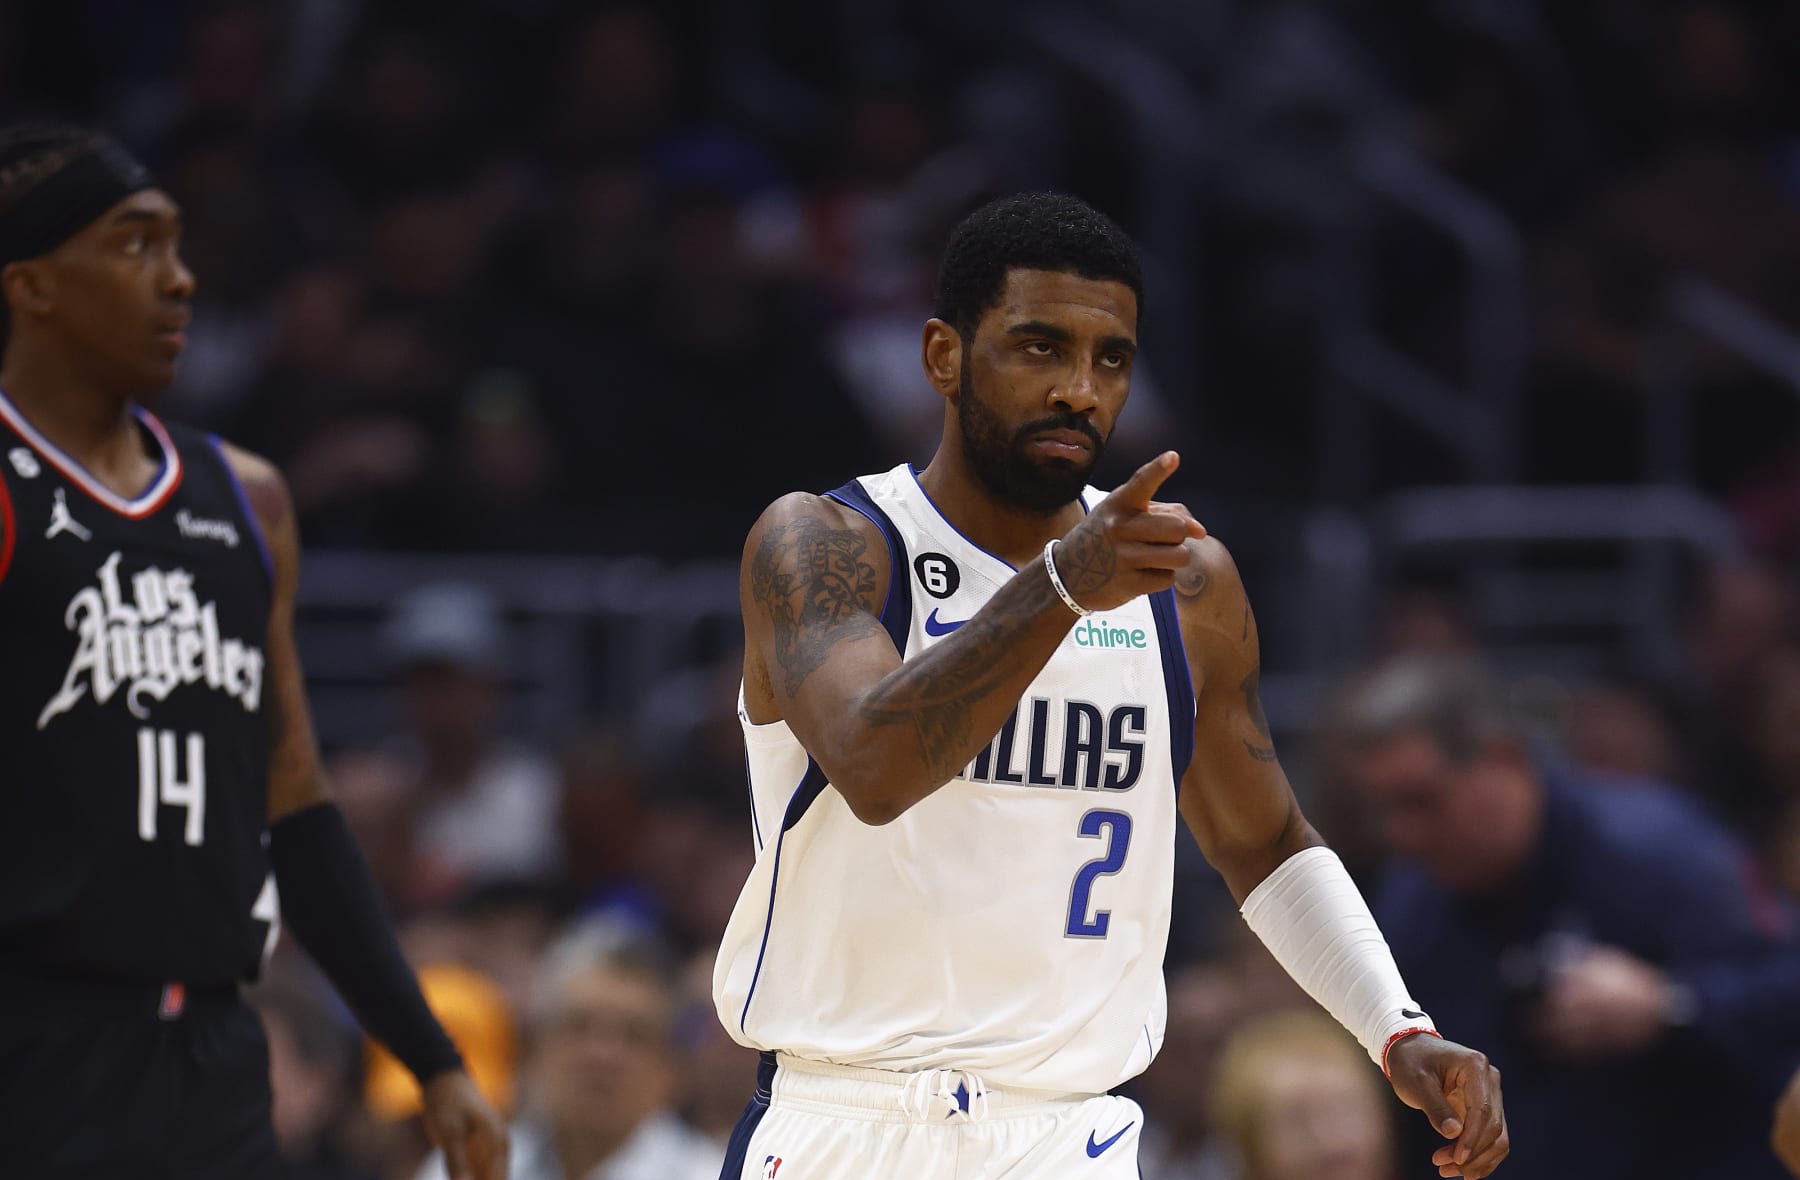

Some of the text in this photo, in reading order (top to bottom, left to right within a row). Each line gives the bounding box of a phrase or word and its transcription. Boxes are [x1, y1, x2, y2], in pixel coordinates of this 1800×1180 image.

[96, 551, 199, 628] Los
[922, 558, 947, 594] 6
[37, 587, 264, 730] Angeles
[1074, 619, 1147, 649] chime
[137, 727, 206, 847] 14
[1063, 807, 1134, 940] 2
